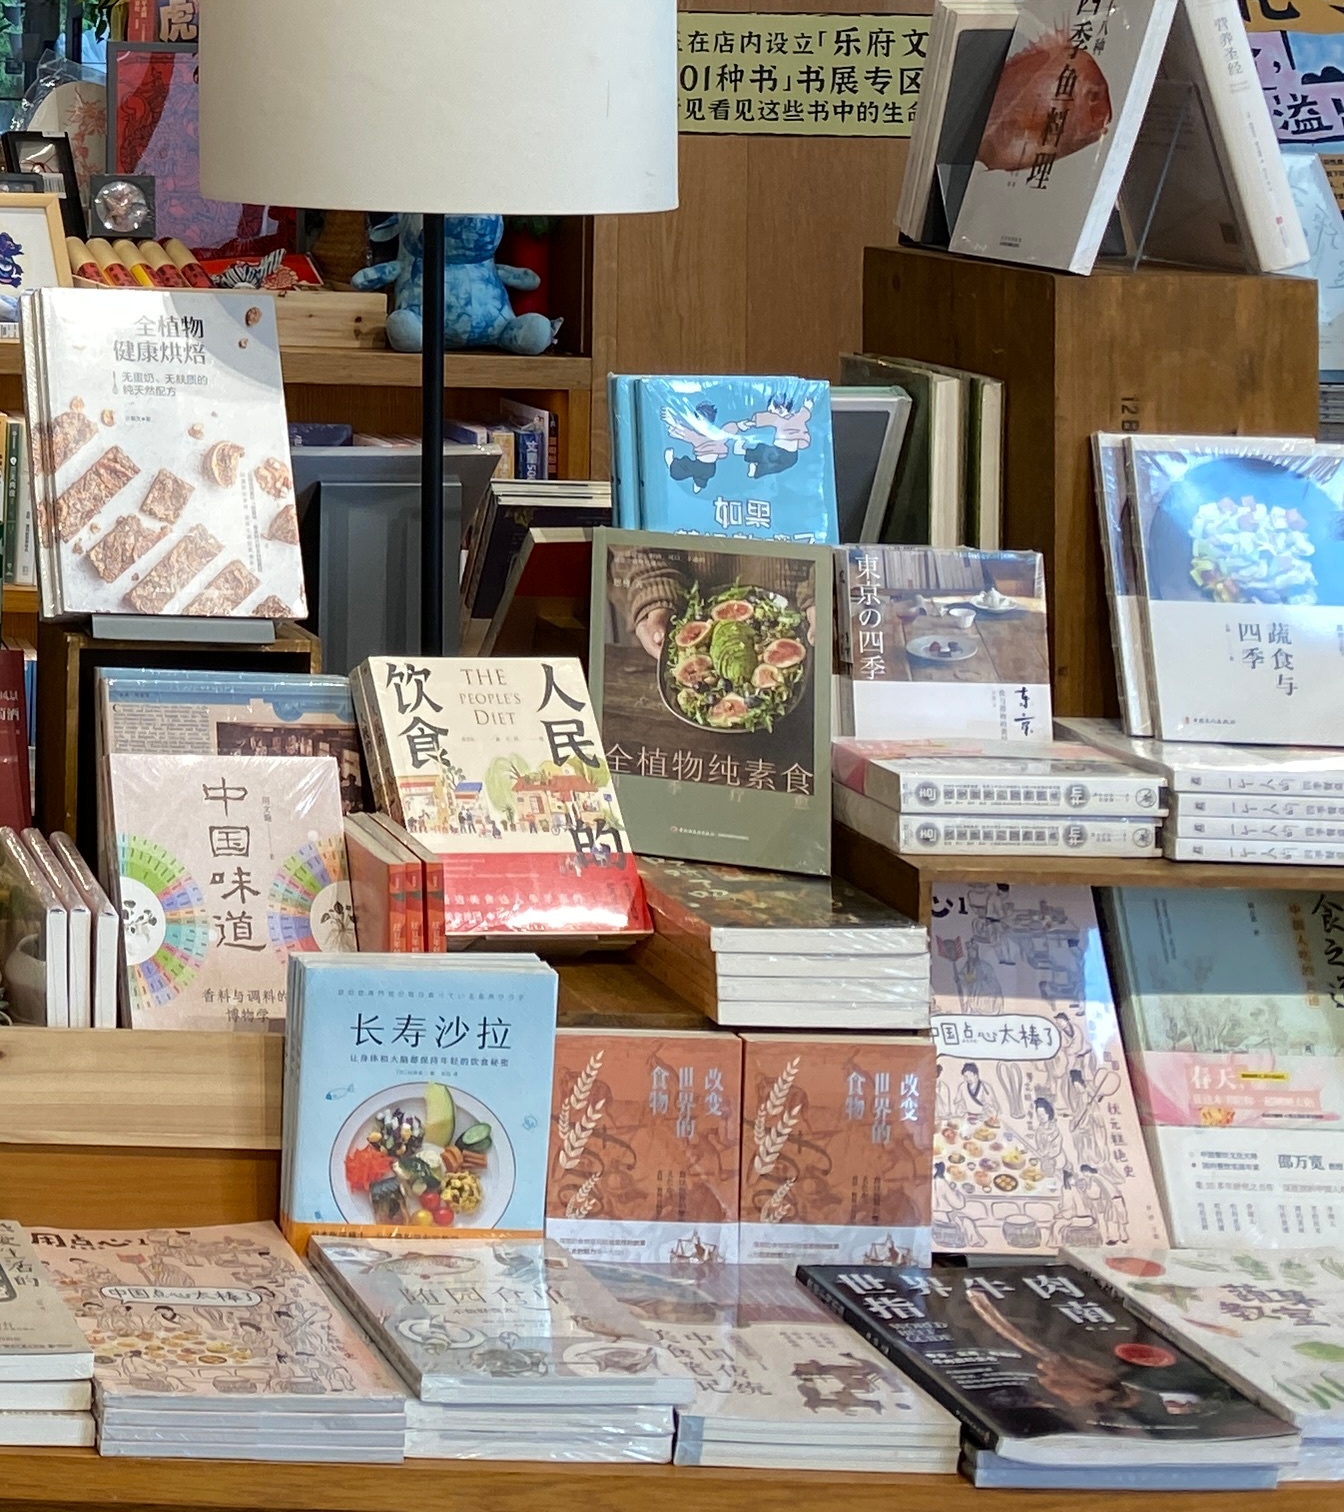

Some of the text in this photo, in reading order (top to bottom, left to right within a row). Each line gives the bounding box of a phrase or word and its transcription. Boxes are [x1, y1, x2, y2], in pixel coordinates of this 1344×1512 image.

[134, 314, 205, 340] 全植物
[113, 341, 207, 366] 健康烘焙
[712, 495, 772, 529] 如果
[460, 668, 508, 687] THE
[385, 661, 450, 770] 饮食
[458, 692, 522, 706] PEOPLE'S
[605, 741, 815, 796] 全植物纯素食
[201, 776, 268, 954] 中国味道
[349, 1012, 512, 1051] 长寿沙拉
